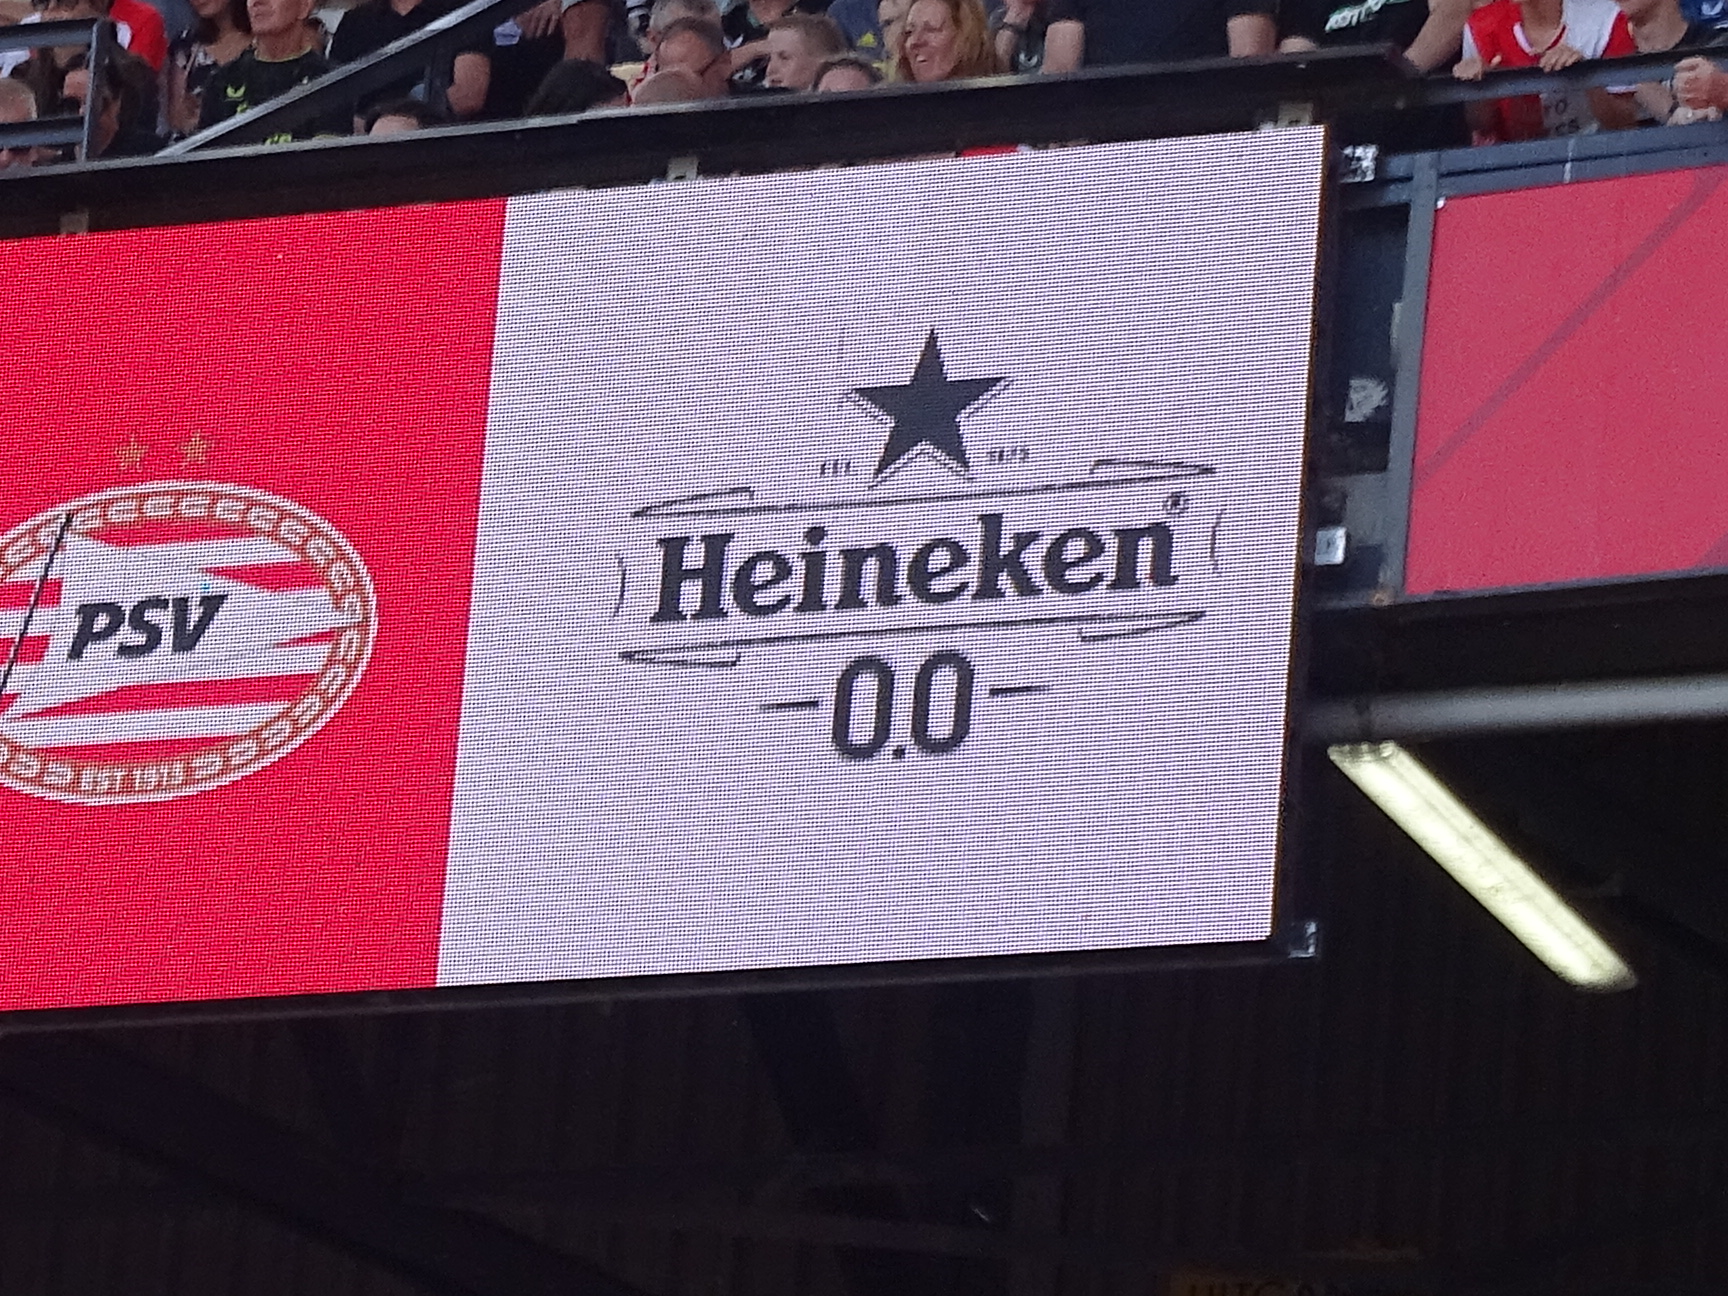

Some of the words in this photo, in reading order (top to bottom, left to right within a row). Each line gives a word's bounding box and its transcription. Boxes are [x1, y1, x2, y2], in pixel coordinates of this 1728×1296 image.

[650, 512, 1179, 623] Heineken
[67, 594, 228, 663] PSV
[831, 650, 976, 761] 0.0
